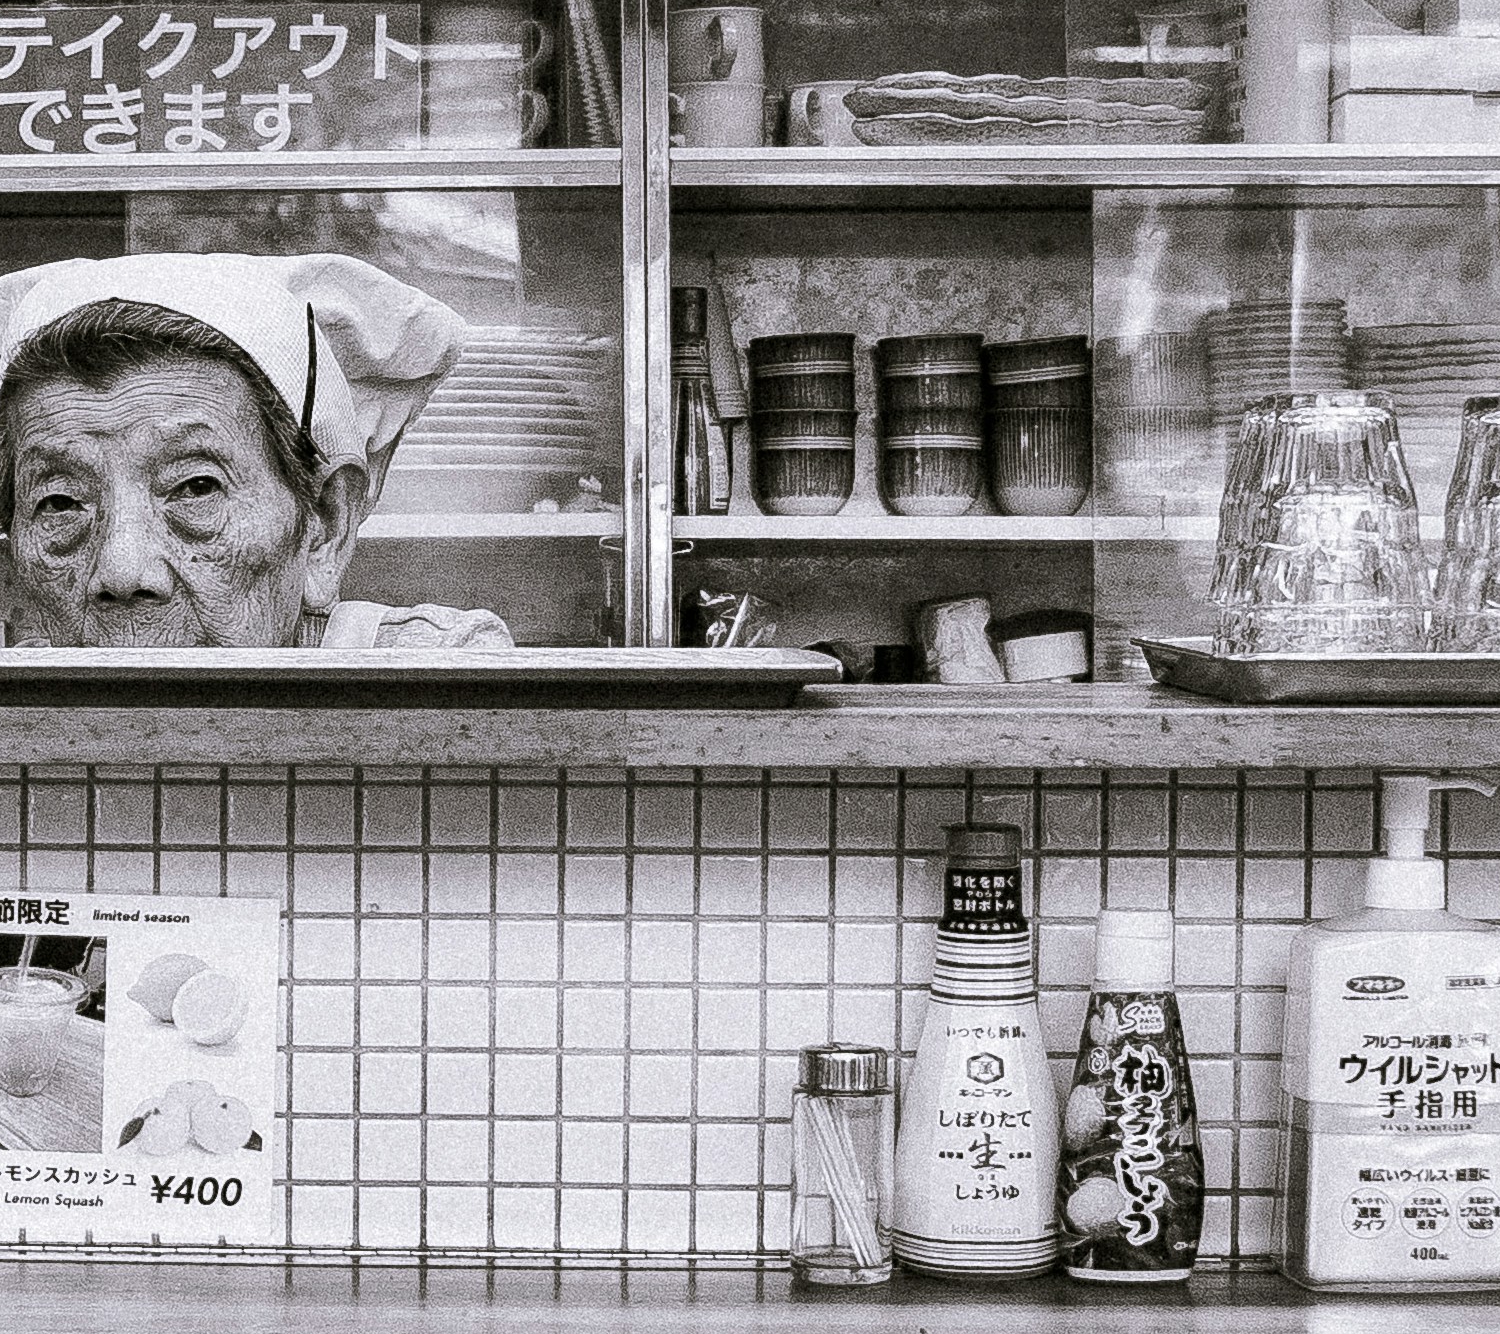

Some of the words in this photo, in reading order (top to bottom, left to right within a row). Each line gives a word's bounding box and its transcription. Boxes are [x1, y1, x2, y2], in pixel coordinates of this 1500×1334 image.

[143, 912, 190, 924] season
[1376, 1090, 1478, 1119] 手指用
[937, 1110, 1032, 1129] しぼりたて
[150, 1174, 244, 1207] ¥400
[954, 1184, 1019, 1201] しょうゆ
[951, 1223, 1021, 1236] kikkoman
